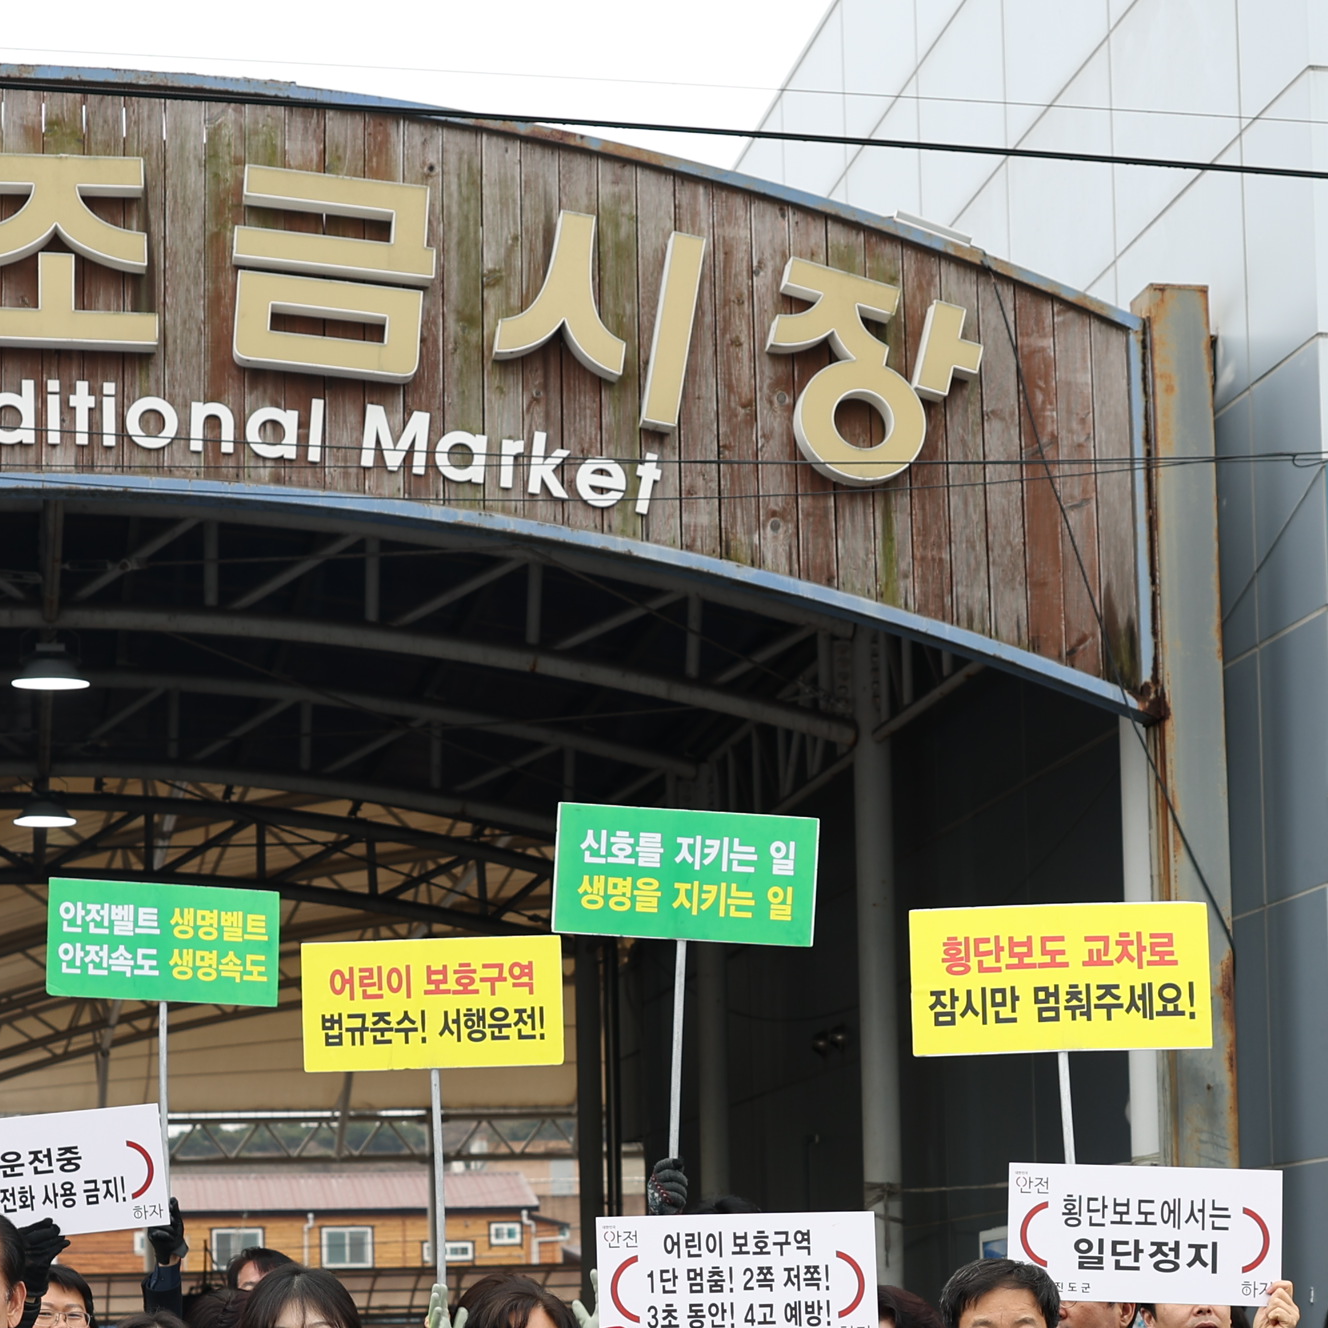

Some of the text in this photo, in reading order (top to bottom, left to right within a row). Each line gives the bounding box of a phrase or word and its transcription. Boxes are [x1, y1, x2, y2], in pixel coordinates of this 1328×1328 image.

[359, 405, 664, 516] Market
[580, 829, 796, 875] 신호를 지키는 일
[577, 875, 793, 921] 생명을 지키는 일
[58, 900, 269, 943] 안전벨트 생명벨트
[58, 942, 268, 983] 안전속도 생명속도
[941, 931, 1179, 975] 횡단보도 교차로
[328, 960, 535, 1000] 어린이 보호구역
[928, 980, 1196, 1026] 잠시만 멈춰주세요!
[320, 1006, 547, 1047] 법규준수! 서행운전!
[42, 1180, 77, 1210] 사용
[83, 1175, 127, 1205] 금지!
[1015, 1176, 1050, 1195] 안전
[1062, 1194, 1232, 1231] 횡단보도에서는
[603, 1230, 639, 1249] 안전
[663, 1229, 812, 1259] 어린이 보호구역
[1073, 1237, 1219, 1274] 일단정지
[647, 1264, 831, 1294] 1단 멈춤! 2쪽 저쪽!
[647, 1299, 832, 1328] 3초 동안! 4고 예방!
